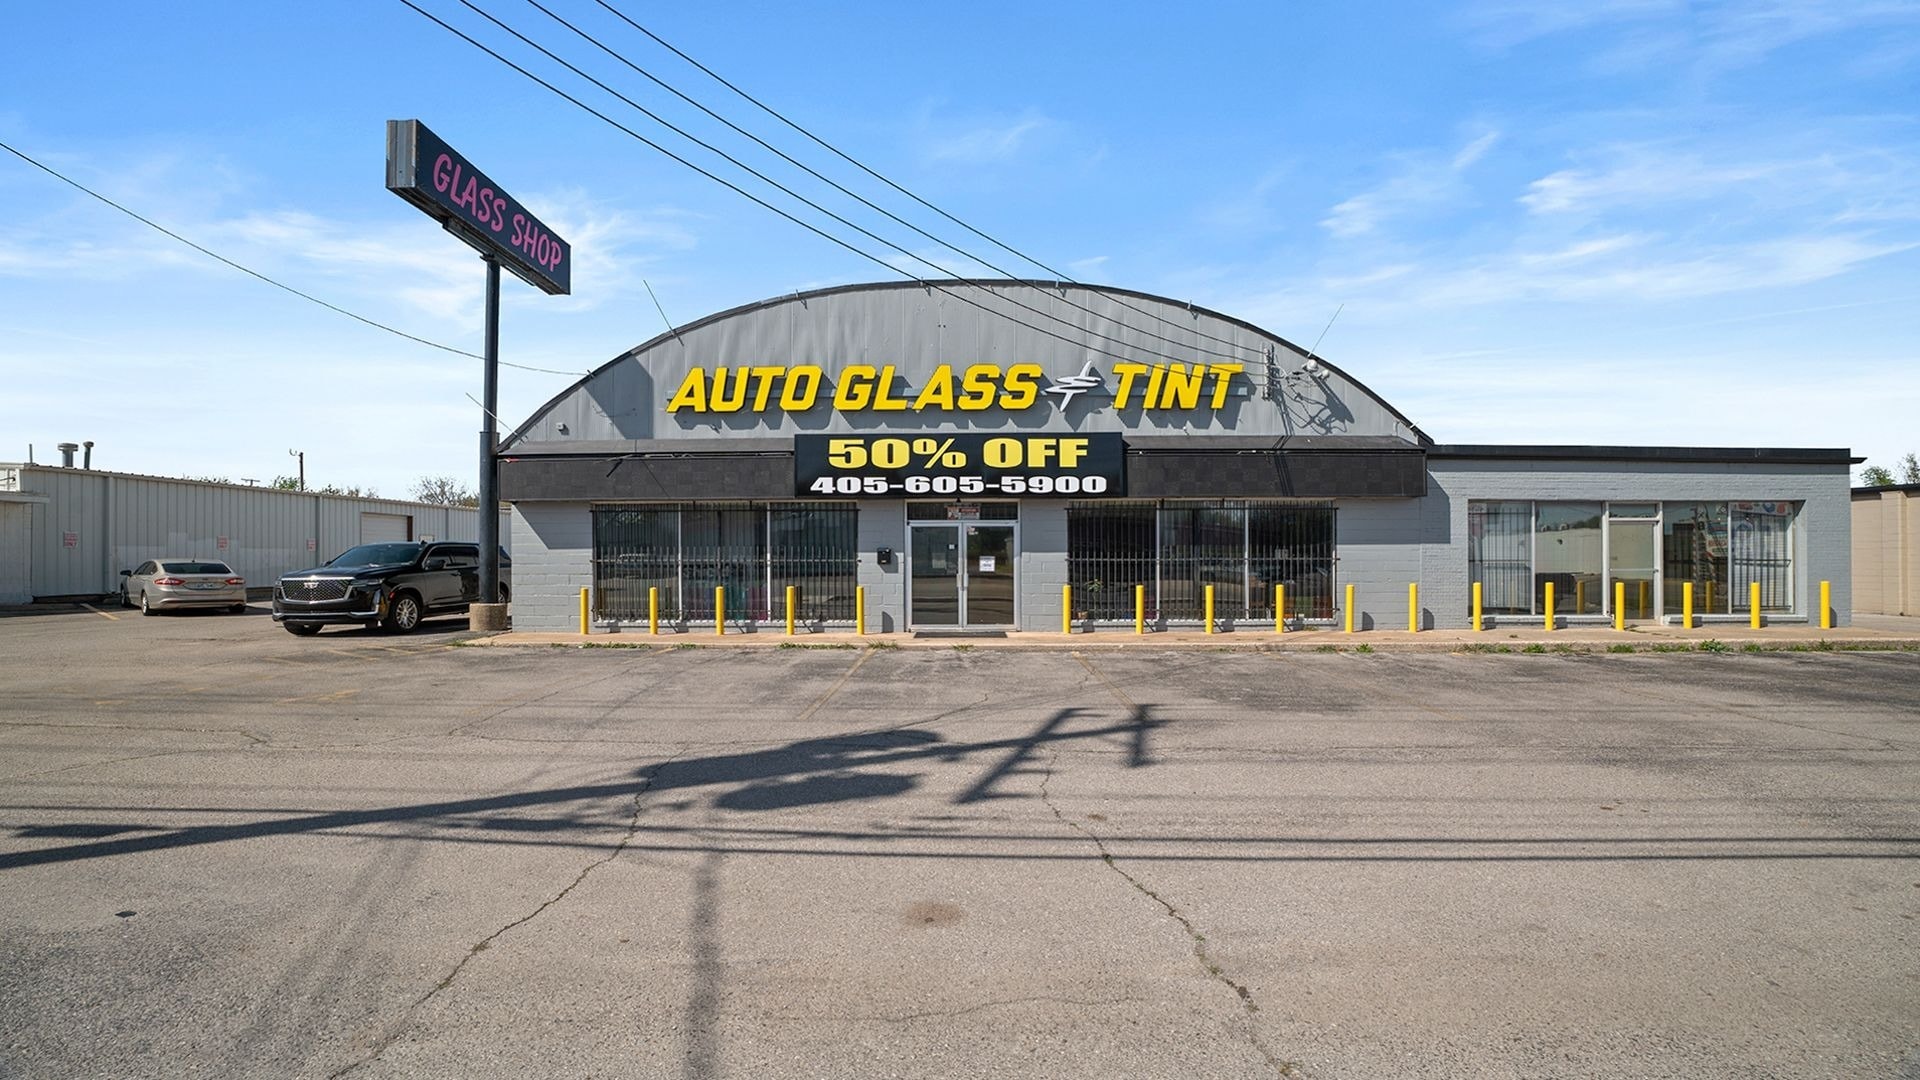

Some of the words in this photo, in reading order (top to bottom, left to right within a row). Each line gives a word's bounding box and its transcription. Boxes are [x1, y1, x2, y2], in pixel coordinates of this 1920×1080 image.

[432, 153, 507, 233] GLASS
[511, 213, 563, 272] SHOP
[666, 363, 823, 414] AUTO
[832, 362, 1044, 412] GLASS
[1111, 361, 1245, 410] TINT
[827, 437, 967, 469] 50%
[983, 437, 1089, 468] OFF
[809, 475, 1107, 495] 405-605-5900
